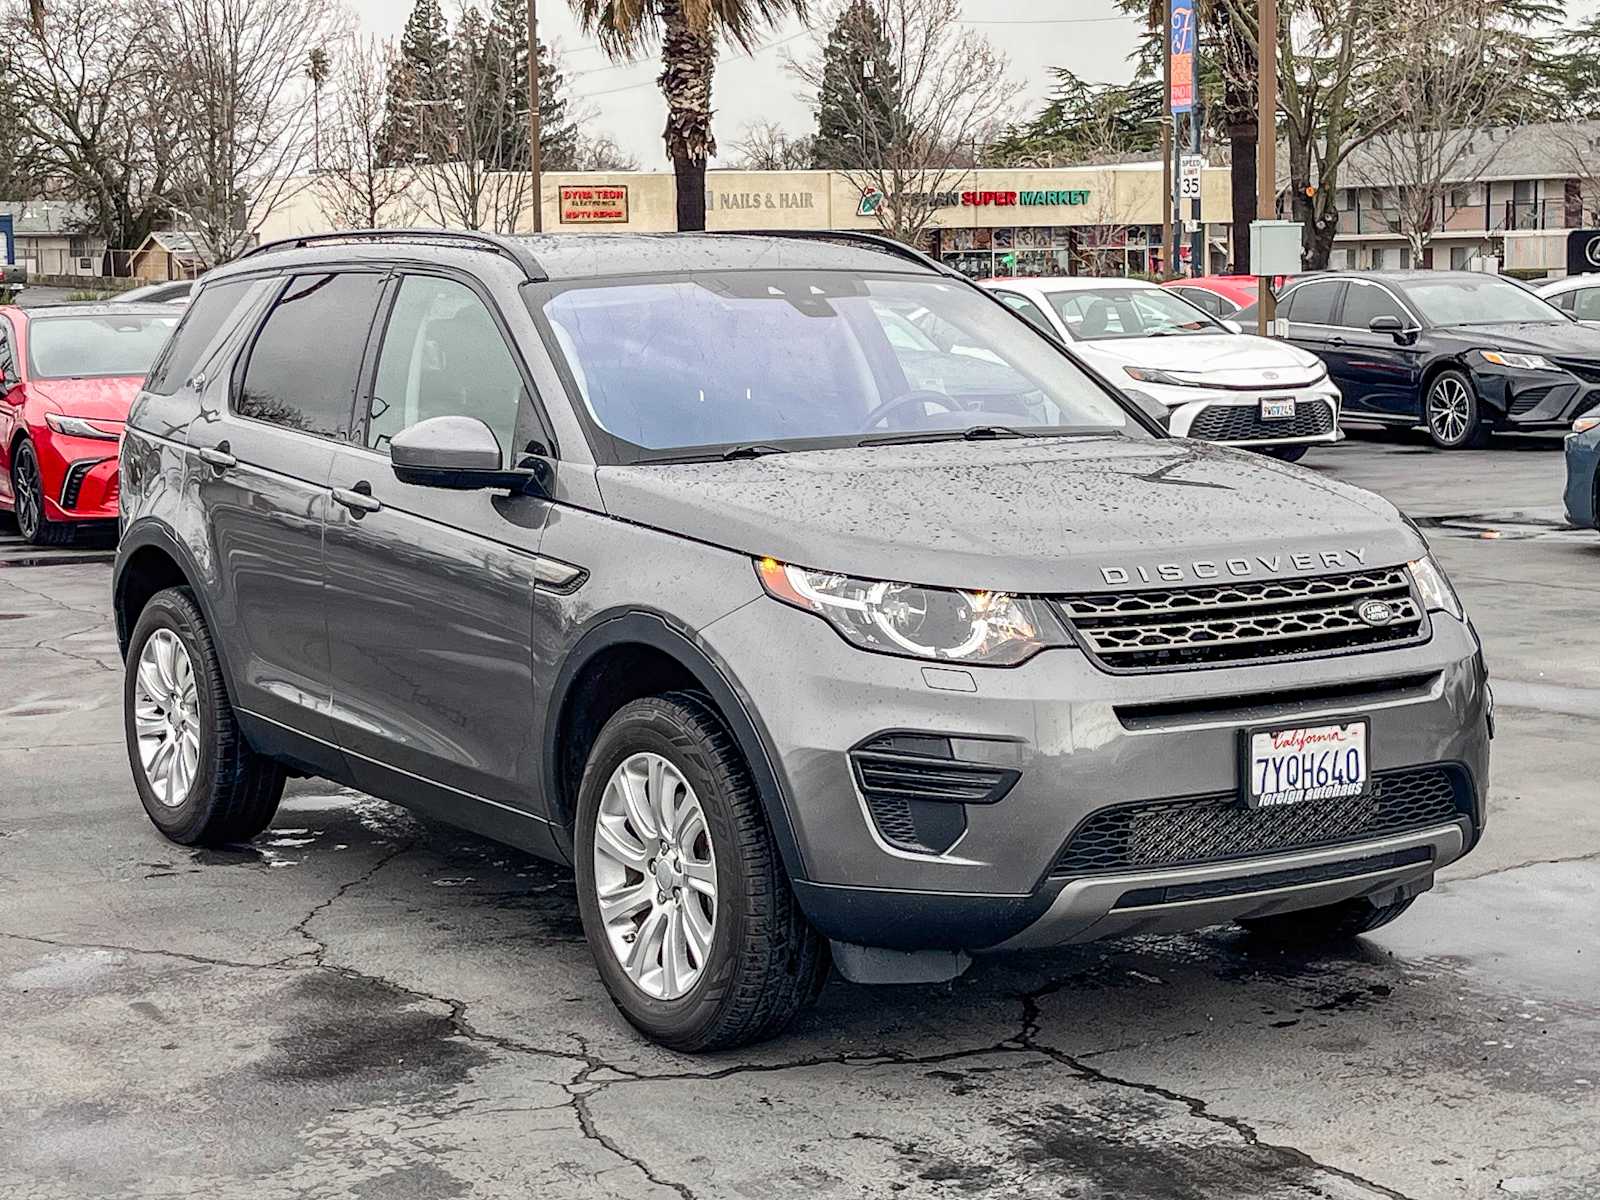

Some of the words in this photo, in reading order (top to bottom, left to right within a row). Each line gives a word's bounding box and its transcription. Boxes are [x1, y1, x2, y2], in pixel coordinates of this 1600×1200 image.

[1182, 159, 1200, 167] SPEED
[1183, 178, 1199, 194] 35
[720, 193, 760, 209] NAILS
[765, 193, 776, 209] &
[779, 192, 814, 208] HAIR
[961, 191, 1017, 206] SUPER
[1019, 190, 1091, 206] MARKET
[1100, 548, 1366, 585] DISCOVERY
[1271, 728, 1346, 752] California
[1256, 748, 1360, 794] 7YQH640
[1258, 787, 1306, 807] foreign
[1304, 782, 1364, 801] autohaus
